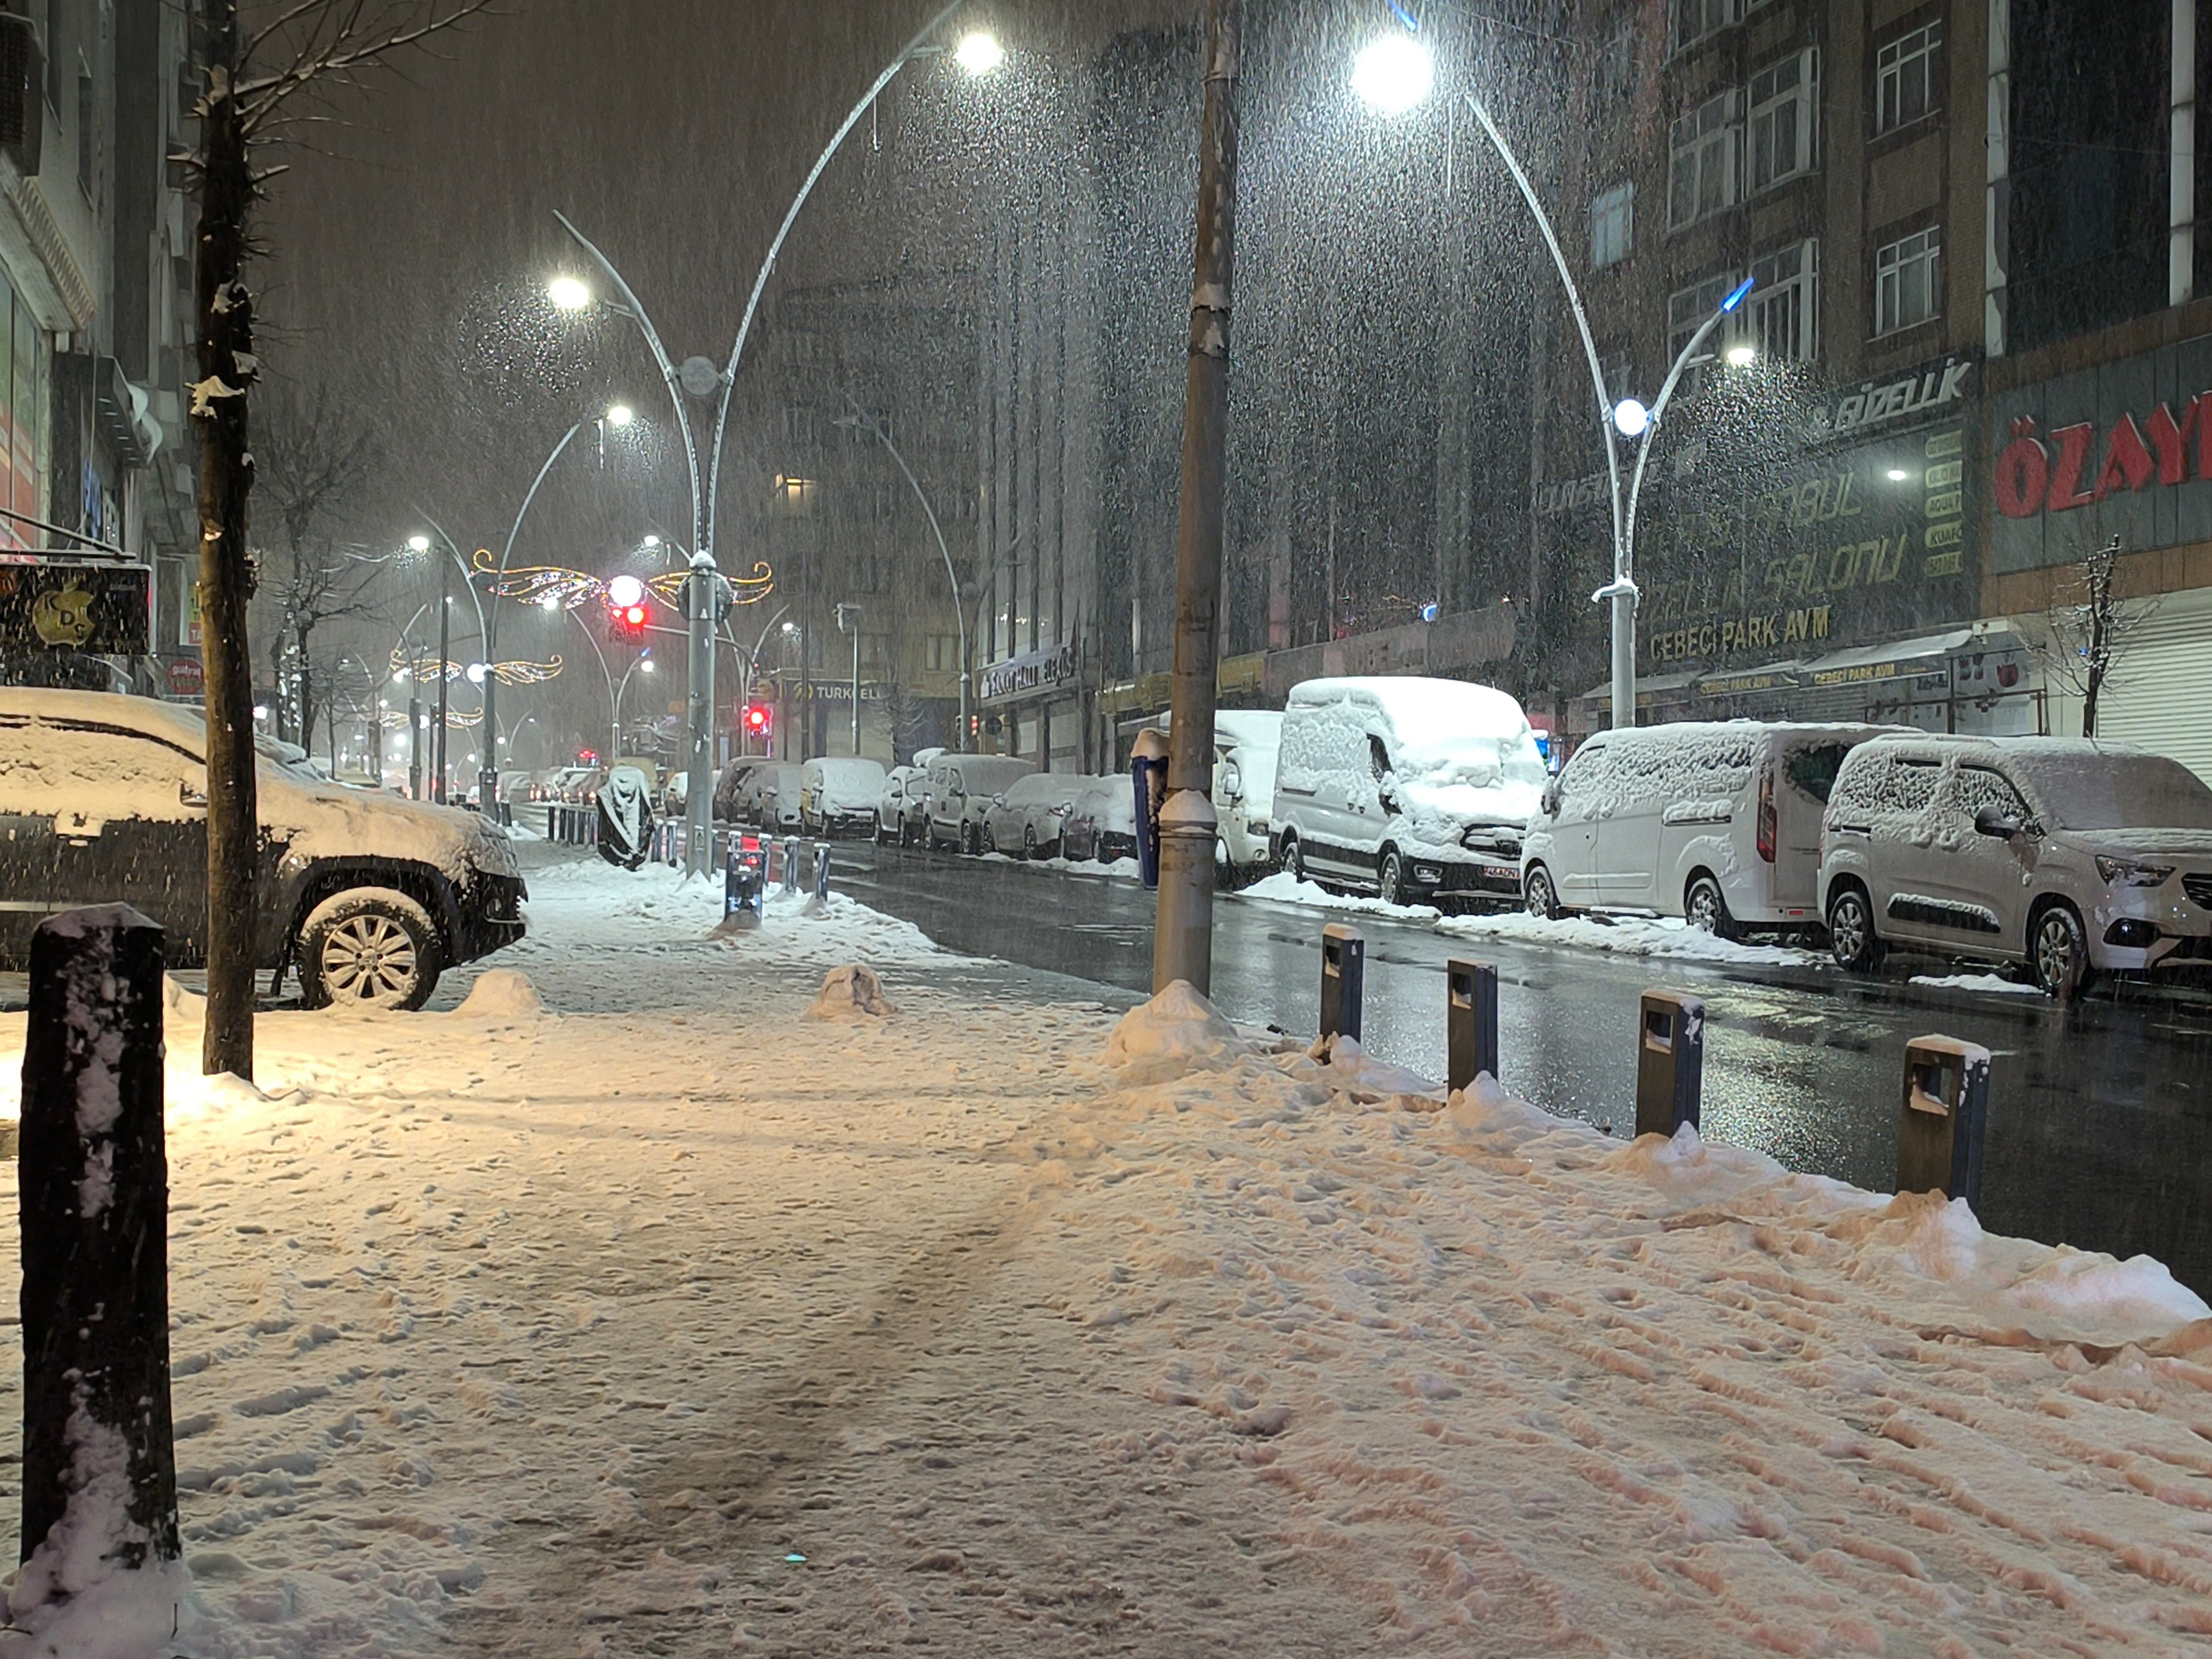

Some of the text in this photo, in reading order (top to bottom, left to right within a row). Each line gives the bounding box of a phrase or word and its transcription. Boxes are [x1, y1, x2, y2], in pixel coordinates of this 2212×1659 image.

[1995, 390, 2212, 518] ÖZAY
[1722, 613, 1779, 652] PARK
[1783, 605, 1831, 644] AVM
[1849, 666, 1873, 681] PARK
[1875, 663, 1895, 678] AVM
